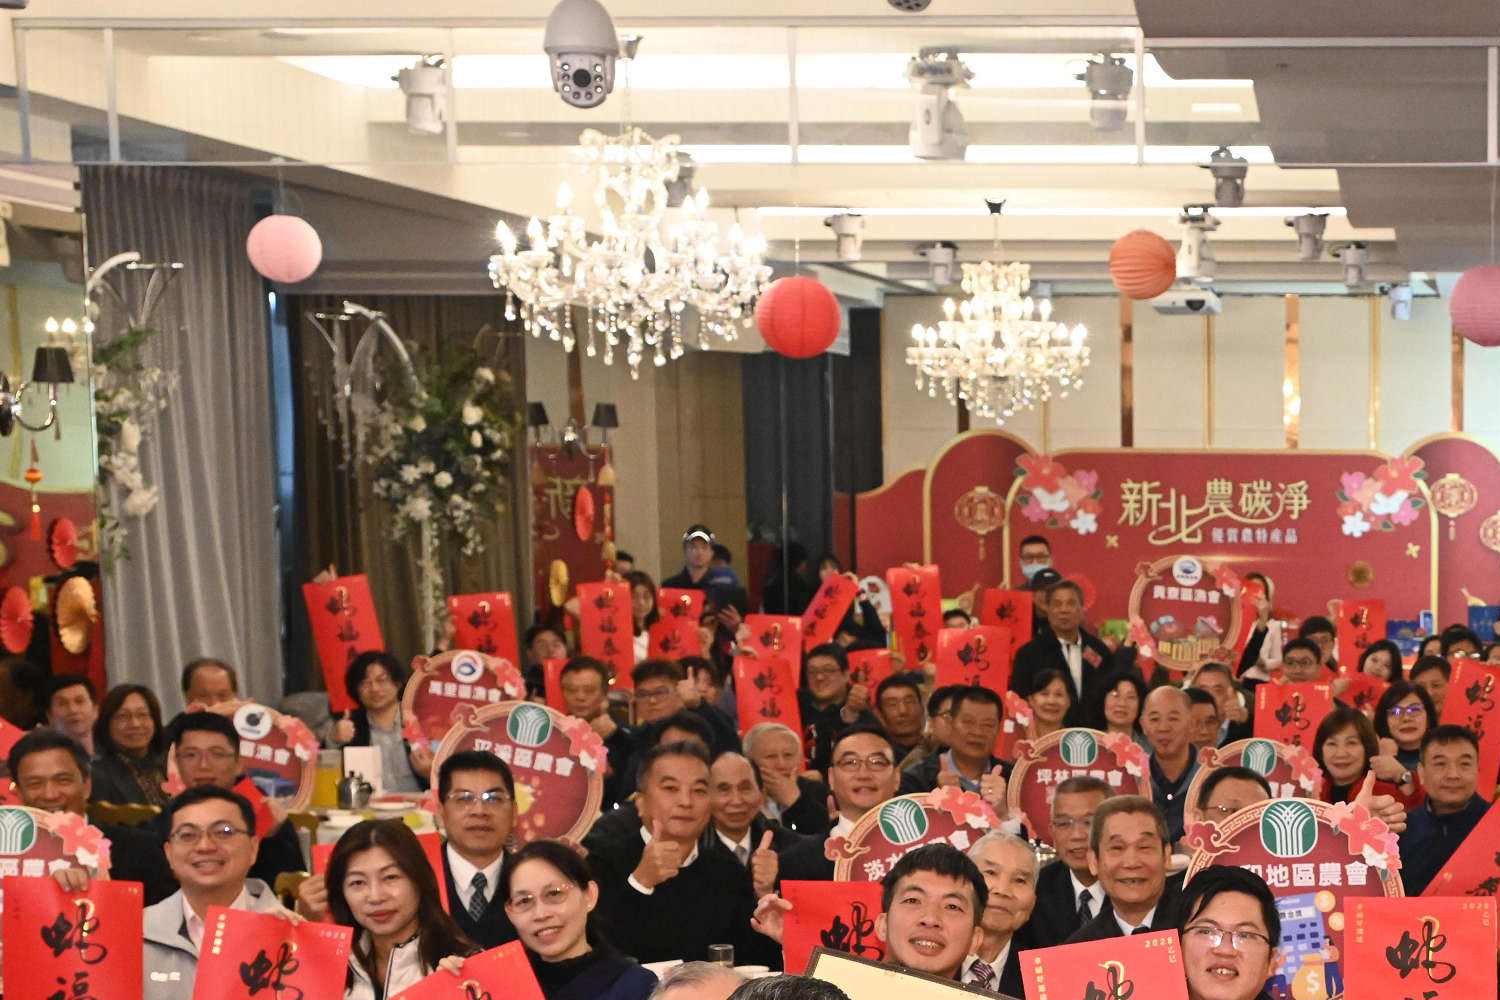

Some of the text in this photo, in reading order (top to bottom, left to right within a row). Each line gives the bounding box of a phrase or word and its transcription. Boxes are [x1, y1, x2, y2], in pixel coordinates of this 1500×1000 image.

[1117, 478, 1311, 545] 新北農碳淨
